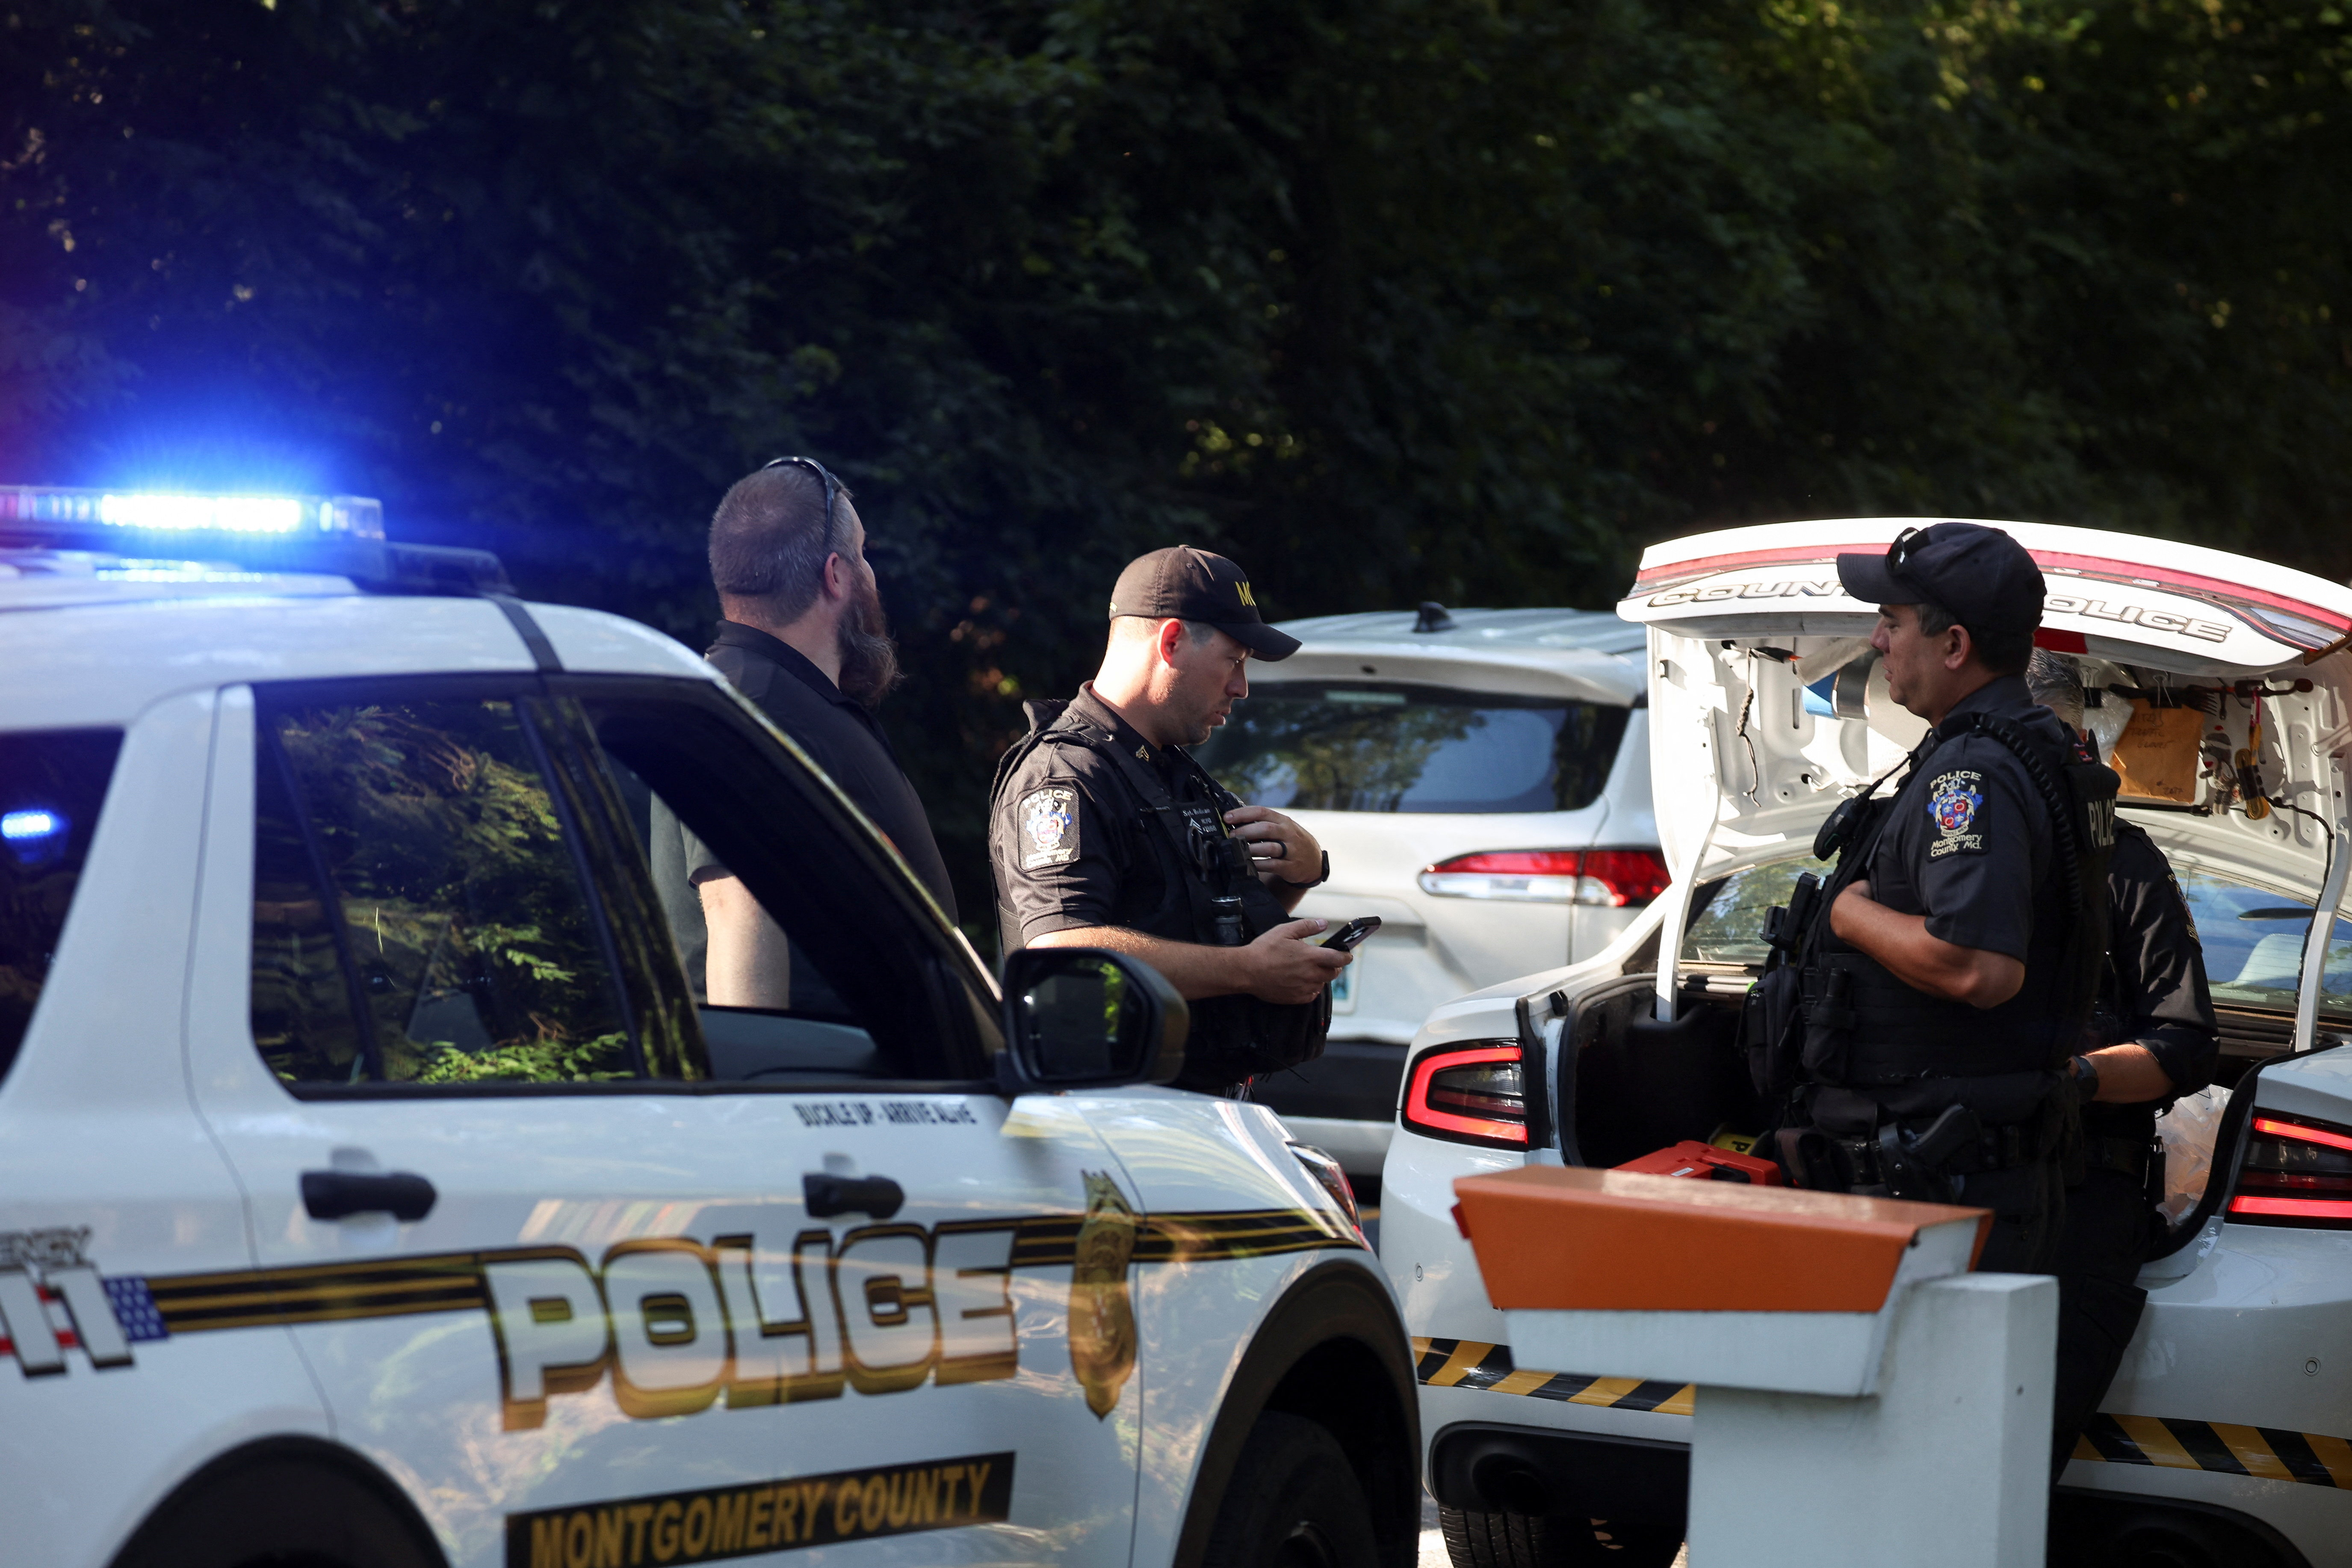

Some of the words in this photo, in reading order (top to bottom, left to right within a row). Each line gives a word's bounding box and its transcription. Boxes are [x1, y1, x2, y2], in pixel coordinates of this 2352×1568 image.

[1647, 581, 1850, 607] COUN
[2044, 593, 2233, 643] OLICE
[1022, 789, 1073, 809] POLICE
[1930, 770, 1982, 790] POLICE
[1931, 834, 1983, 850] Montgomery
[483, 1222, 1019, 1432] POLICE
[530, 1481, 829, 1568] MONTGOMERY
[834, 1462, 991, 1536] COUNTY
